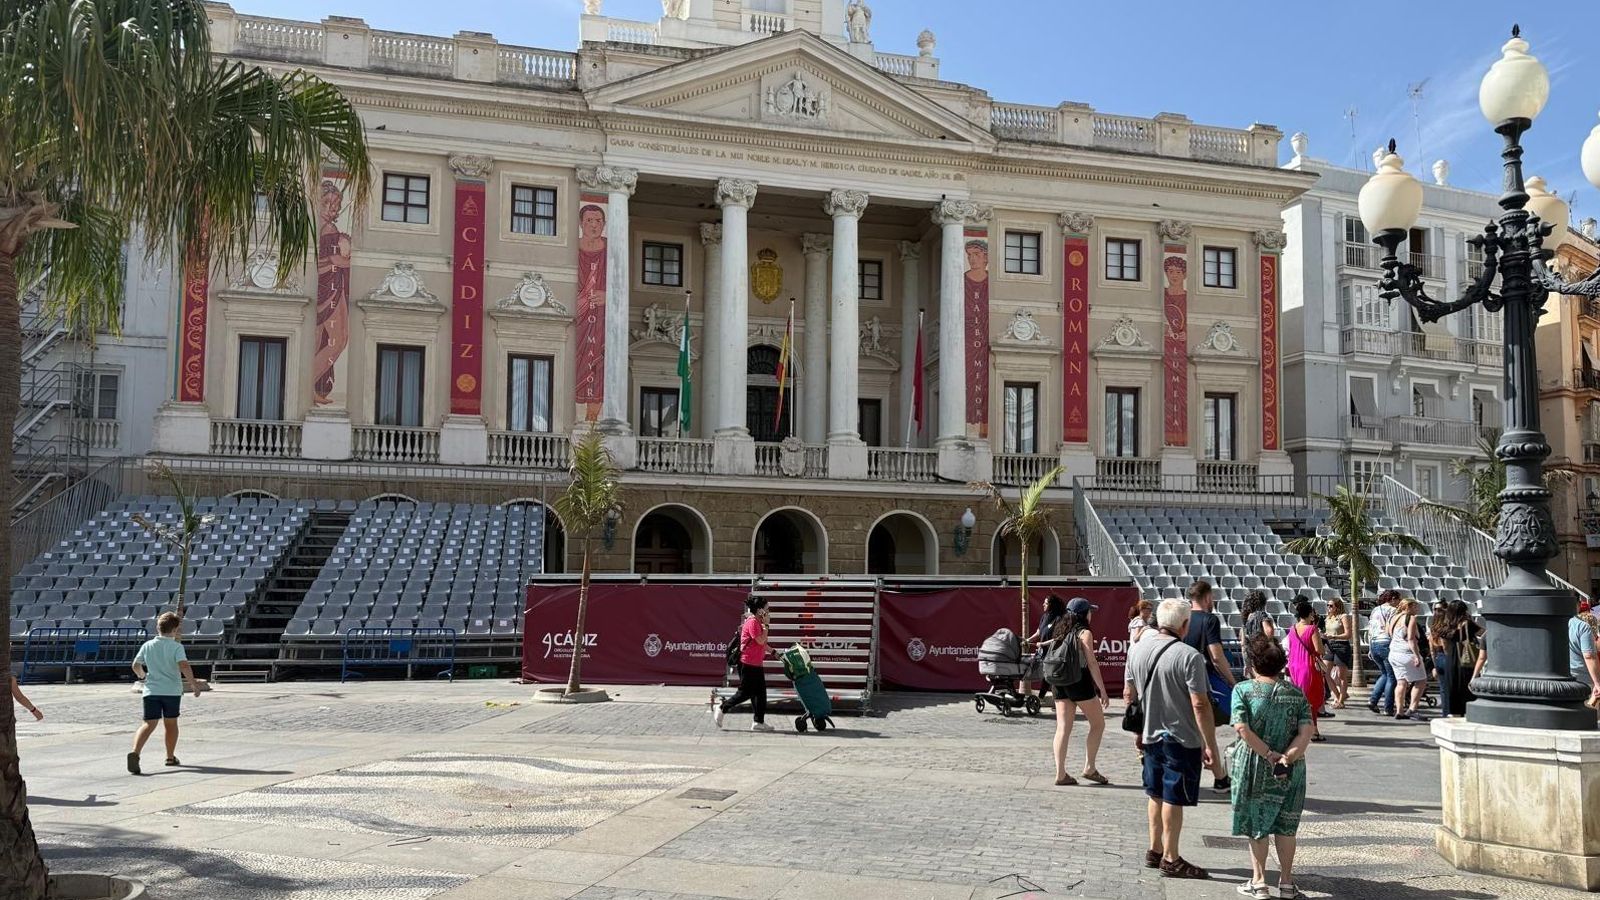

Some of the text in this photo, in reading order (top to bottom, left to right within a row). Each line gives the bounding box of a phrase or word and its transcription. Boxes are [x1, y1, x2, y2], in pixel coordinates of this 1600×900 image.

[702, 148, 711, 157] DE
[716, 150, 726, 158] LA
[326, 245, 338, 384] TELETUSA
[460, 227, 477, 358] CÁDIZ
[586, 262, 597, 396] BALBO MAYOR
[973, 292, 982, 348] BALBO
[1068, 277, 1082, 396] ROMANA
[1171, 318, 1180, 426] COLUMELA
[554, 629, 598, 646] CÁIZ
[664, 640, 727, 652] Ayuntamiento de
[929, 645, 979, 656] Ayuntamient
